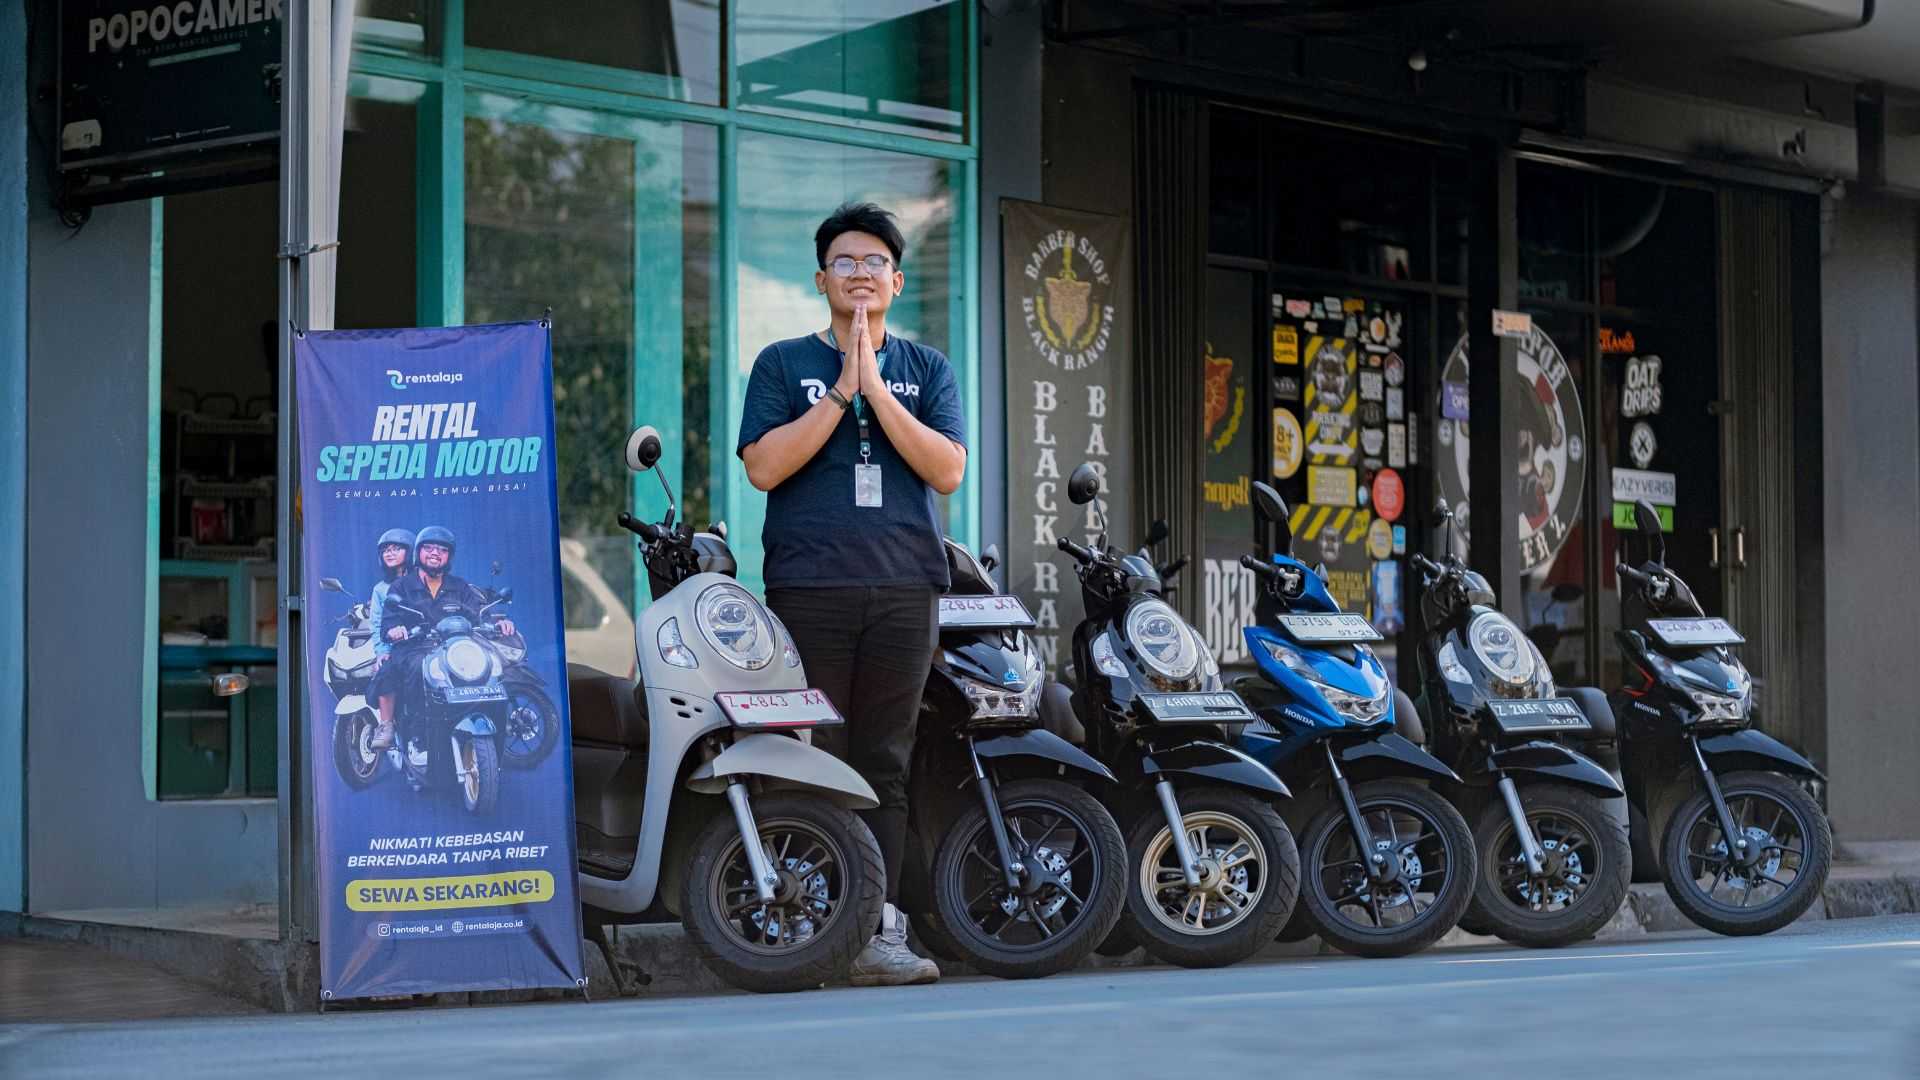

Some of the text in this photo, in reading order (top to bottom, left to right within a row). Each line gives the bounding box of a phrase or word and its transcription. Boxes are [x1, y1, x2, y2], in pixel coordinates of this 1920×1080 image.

[1024, 229, 1112, 286] BARBER SHOP
[1022, 296, 1115, 371] BLACK RANGER
[405, 370, 463, 384] rentalaja
[1628, 362, 1659, 389] OAT
[1623, 387, 1662, 412] DRIPS
[371, 402, 479, 441] RENTAL
[316, 436, 542, 482] SEPEDA MOTOR
[1033, 380, 1061, 545] BLACK
[335, 488, 381, 499] SEMUA
[433, 486, 479, 495] SEMUA
[488, 482, 527, 491] BISA!
[723, 692, 826, 708] Z 4843 XX
[1494, 704, 1507, 717] Z
[1634, 701, 1661, 716] HONDA
[1284, 707, 1316, 727] HONDA
[369, 831, 524, 851] NIKMATI KEBEBASAN
[347, 846, 548, 868] BERKENDARA TANPA RIBET
[359, 878, 541, 904] SEWA SEKARANG!
